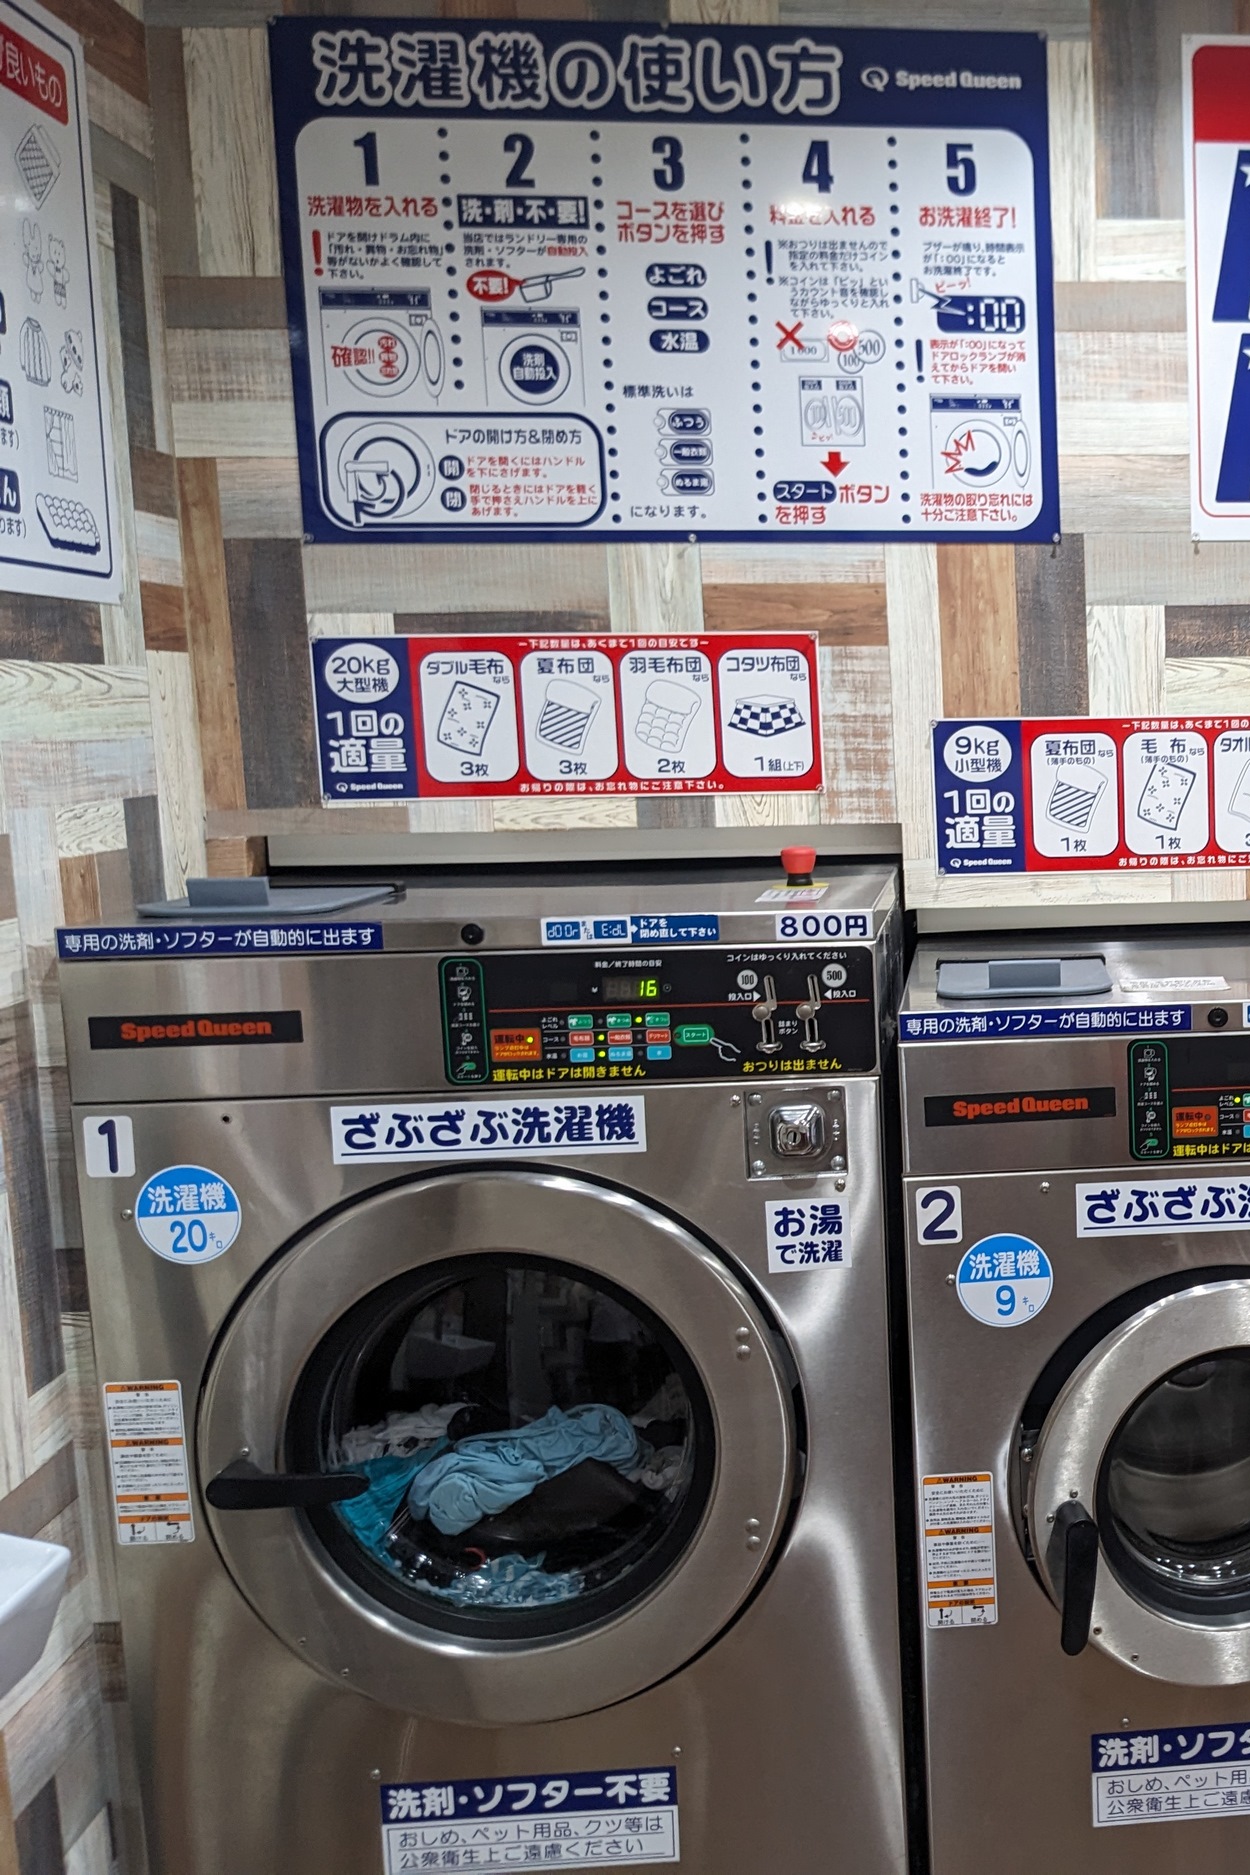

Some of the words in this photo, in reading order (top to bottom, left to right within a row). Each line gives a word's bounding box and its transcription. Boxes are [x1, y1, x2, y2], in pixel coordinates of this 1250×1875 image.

[312, 29, 843, 116] 洗濯機の使い方
[896, 70, 957, 91] Speed
[960, 71, 1022, 90] Queen
[353, 132, 379, 186] 1
[503, 133, 535, 188] 2
[651, 135, 685, 192] 3
[802, 140, 834, 193] 4
[945, 143, 977, 196] 5
[307, 195, 439, 219] 洗濯物を入れる
[616, 201, 725, 222] コースを選び
[919, 206, 1016, 228] お洗濯終了!
[617, 223, 725, 244] ボタンを押す
[649, 267, 705, 284] よごれ
[651, 301, 706, 317] コース
[661, 332, 699, 350] 水温
[623, 385, 693, 398] 標準洗いは
[671, 416, 705, 428] ふつう
[776, 484, 833, 500] スタート
[839, 485, 890, 503] ボタン
[920, 493, 1033, 507] 洗濯物の取り忘れには
[630, 505, 708, 519] になります。
[776, 506, 826, 525] を押す
[921, 508, 1018, 523] 十分ご注意下さい。
[332, 655, 390, 676] 20kg
[426, 657, 504, 676] ダブル毛布
[536, 657, 594, 674] 夏布団
[629, 656, 702, 674] 羽毛布団
[726, 655, 800, 673] コタツ布団
[337, 677, 389, 693] 大型機
[326, 709, 405, 737] 1回の
[327, 738, 407, 773] 適量
[955, 736, 1000, 756] 9kg
[1045, 739, 1096, 757] 夏布団
[1141, 737, 1186, 754] 毛布
[460, 761, 489, 777] 3枚
[559, 760, 588, 775] 3枚
[657, 758, 686, 774] 2枚
[954, 758, 1002, 774] 小型機
[943, 788, 1015, 815] 1回の
[945, 815, 1016, 849] 適量
[1060, 836, 1087, 852] 1枚
[1155, 834, 1181, 850] 1枚
[639, 918, 668, 928] ドアを
[639, 925, 716, 939] 閉め直して下さい
[780, 915, 867, 938] 800円
[726, 951, 848, 963] コインはゆっくり入れてください
[639, 979, 658, 998] 16
[120, 1019, 197, 1043] Speed
[198, 1018, 273, 1038] Queen
[491, 1064, 646, 1082] 運転中はドアは開きません
[742, 1058, 842, 1073] おつりは出ません
[953, 1098, 1020, 1119] Speed
[1022, 1097, 1089, 1113] Queen
[341, 1102, 636, 1150] ざぶざぶ洗濯機
[98, 1119, 119, 1173] 1
[147, 1182, 227, 1215] 洗濯機
[774, 1204, 842, 1237] お湯
[921, 1190, 958, 1240] 2
[170, 1219, 207, 1253] 20
[776, 1240, 843, 1264] で洗濯
[969, 1249, 1040, 1280] 洗濯機
[995, 1285, 1015, 1316] 9
[387, 1772, 671, 1820] 洗剤・ソフター不要
[399, 1815, 664, 1848] おしめ、ペット用品、クツ等は
[400, 1838, 644, 1870] 公衆衛生上ご遠慮ください
